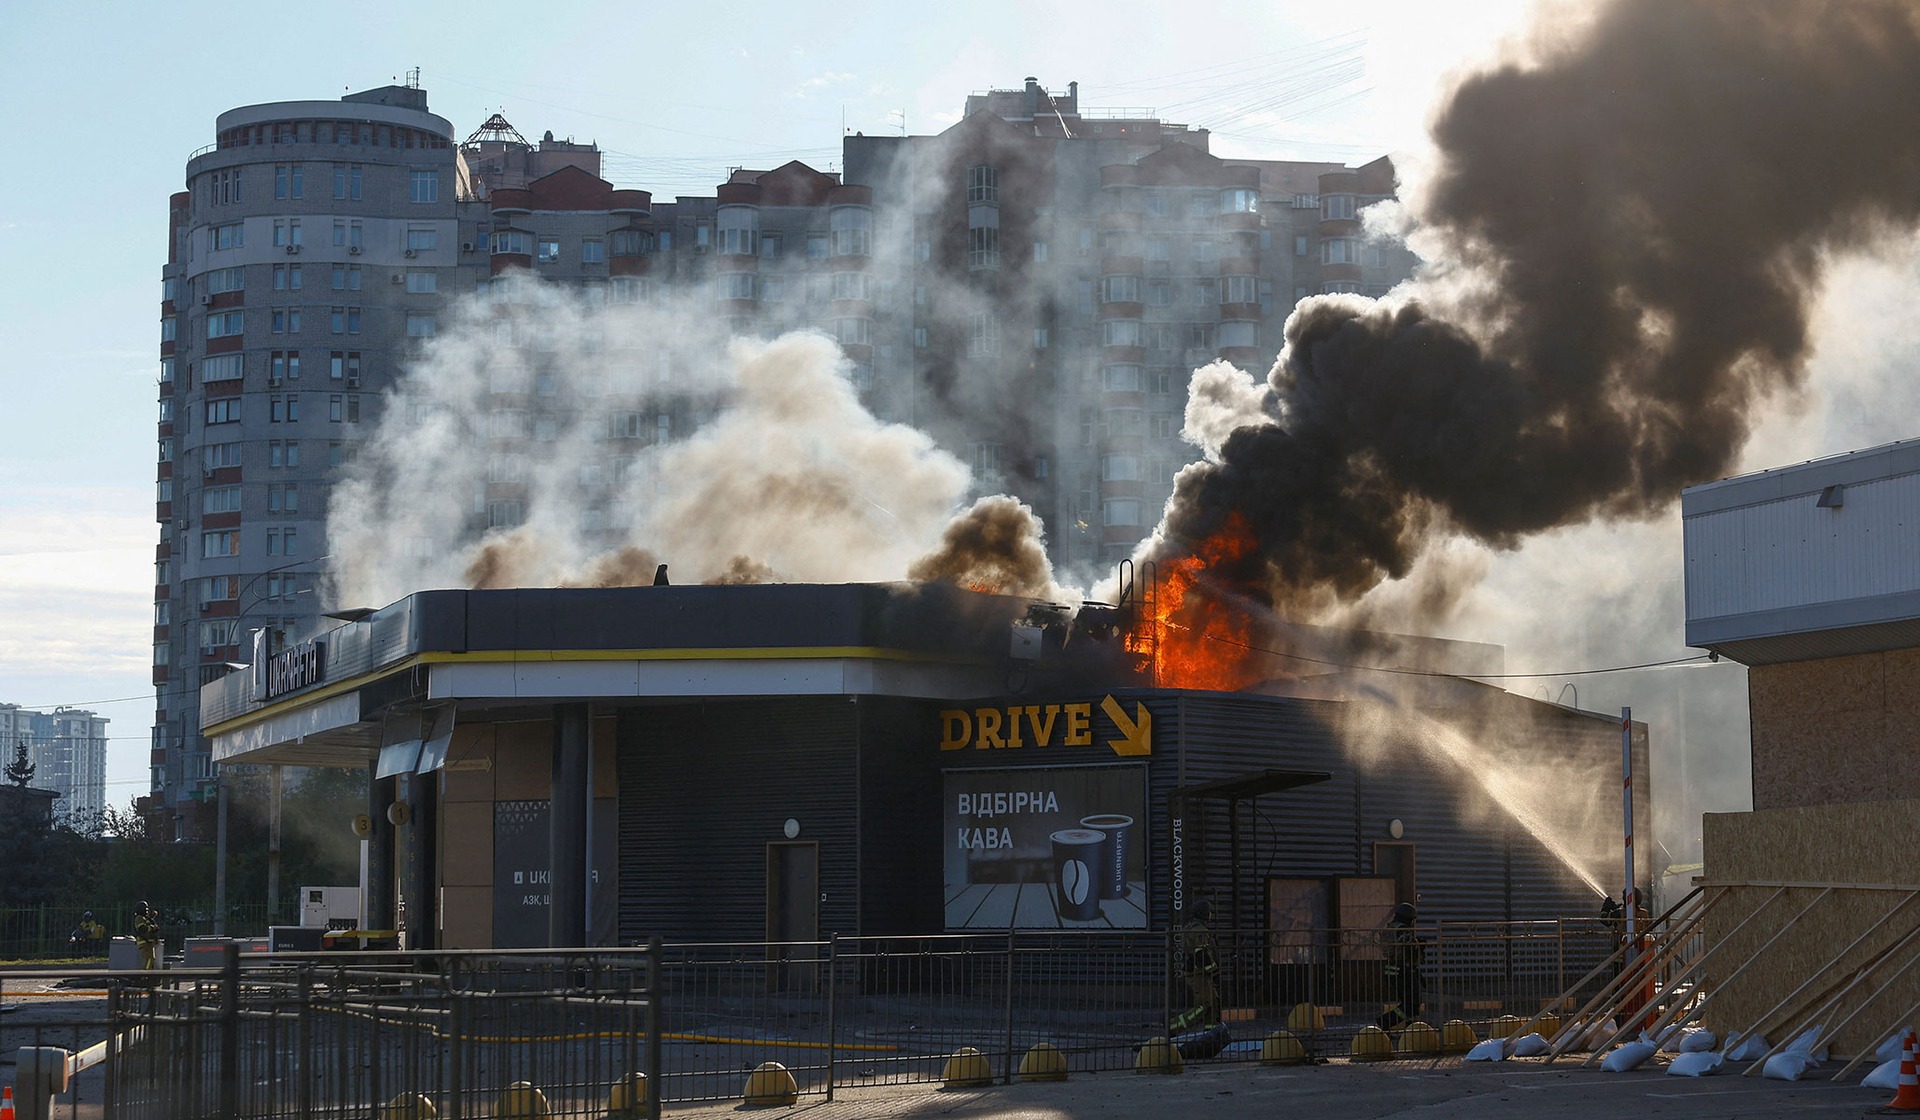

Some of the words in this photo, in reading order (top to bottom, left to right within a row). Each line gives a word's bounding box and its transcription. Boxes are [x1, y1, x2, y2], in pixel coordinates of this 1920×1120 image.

[269, 642, 316, 698] UKRNAFTA
[940, 703, 1092, 751] DRIVE
[957, 791, 1060, 818] ВІДБІРНА
[361, 819, 367, 831] 3
[957, 827, 1015, 850] КАВА
[1173, 818, 1183, 911] BLACKWOOD
